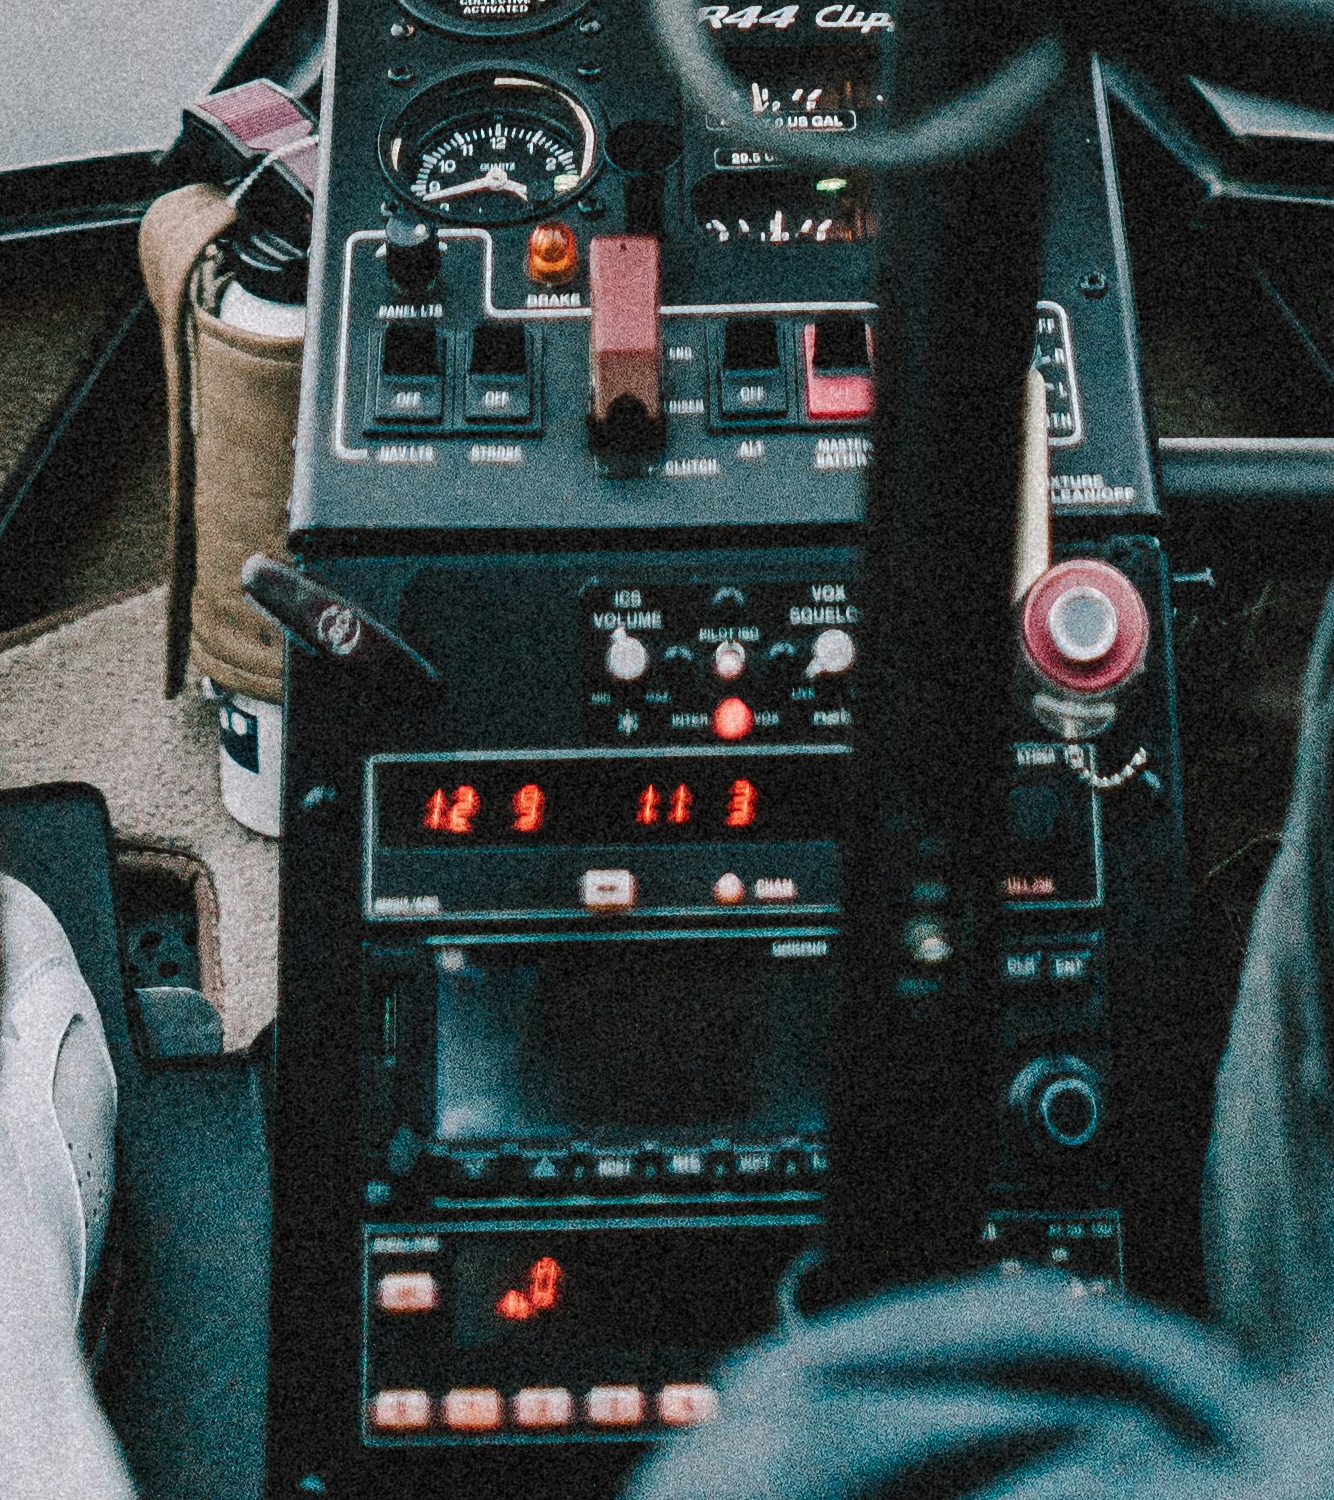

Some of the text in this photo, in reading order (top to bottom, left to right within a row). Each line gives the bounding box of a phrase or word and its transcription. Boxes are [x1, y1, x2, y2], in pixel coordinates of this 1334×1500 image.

[463, 5, 529, 14] ACTIVATED
[698, 4, 896, 35] R44 Clip
[811, 115, 843, 127] GAL
[490, 135, 507, 151] 12
[438, 159, 456, 174] 10
[545, 156, 557, 171] 2
[527, 293, 581, 308] BRAKE
[378, 304, 443, 319] PANEL LTS
[396, 391, 421, 408] OFF
[485, 390, 510, 407] OFF
[740, 385, 764, 402] OFF
[471, 445, 522, 463] STROBE
[615, 589, 641, 608] ICS
[811, 584, 846, 601] VOX
[593, 611, 662, 629] VOLUME
[790, 606, 857, 625] SQUELC
